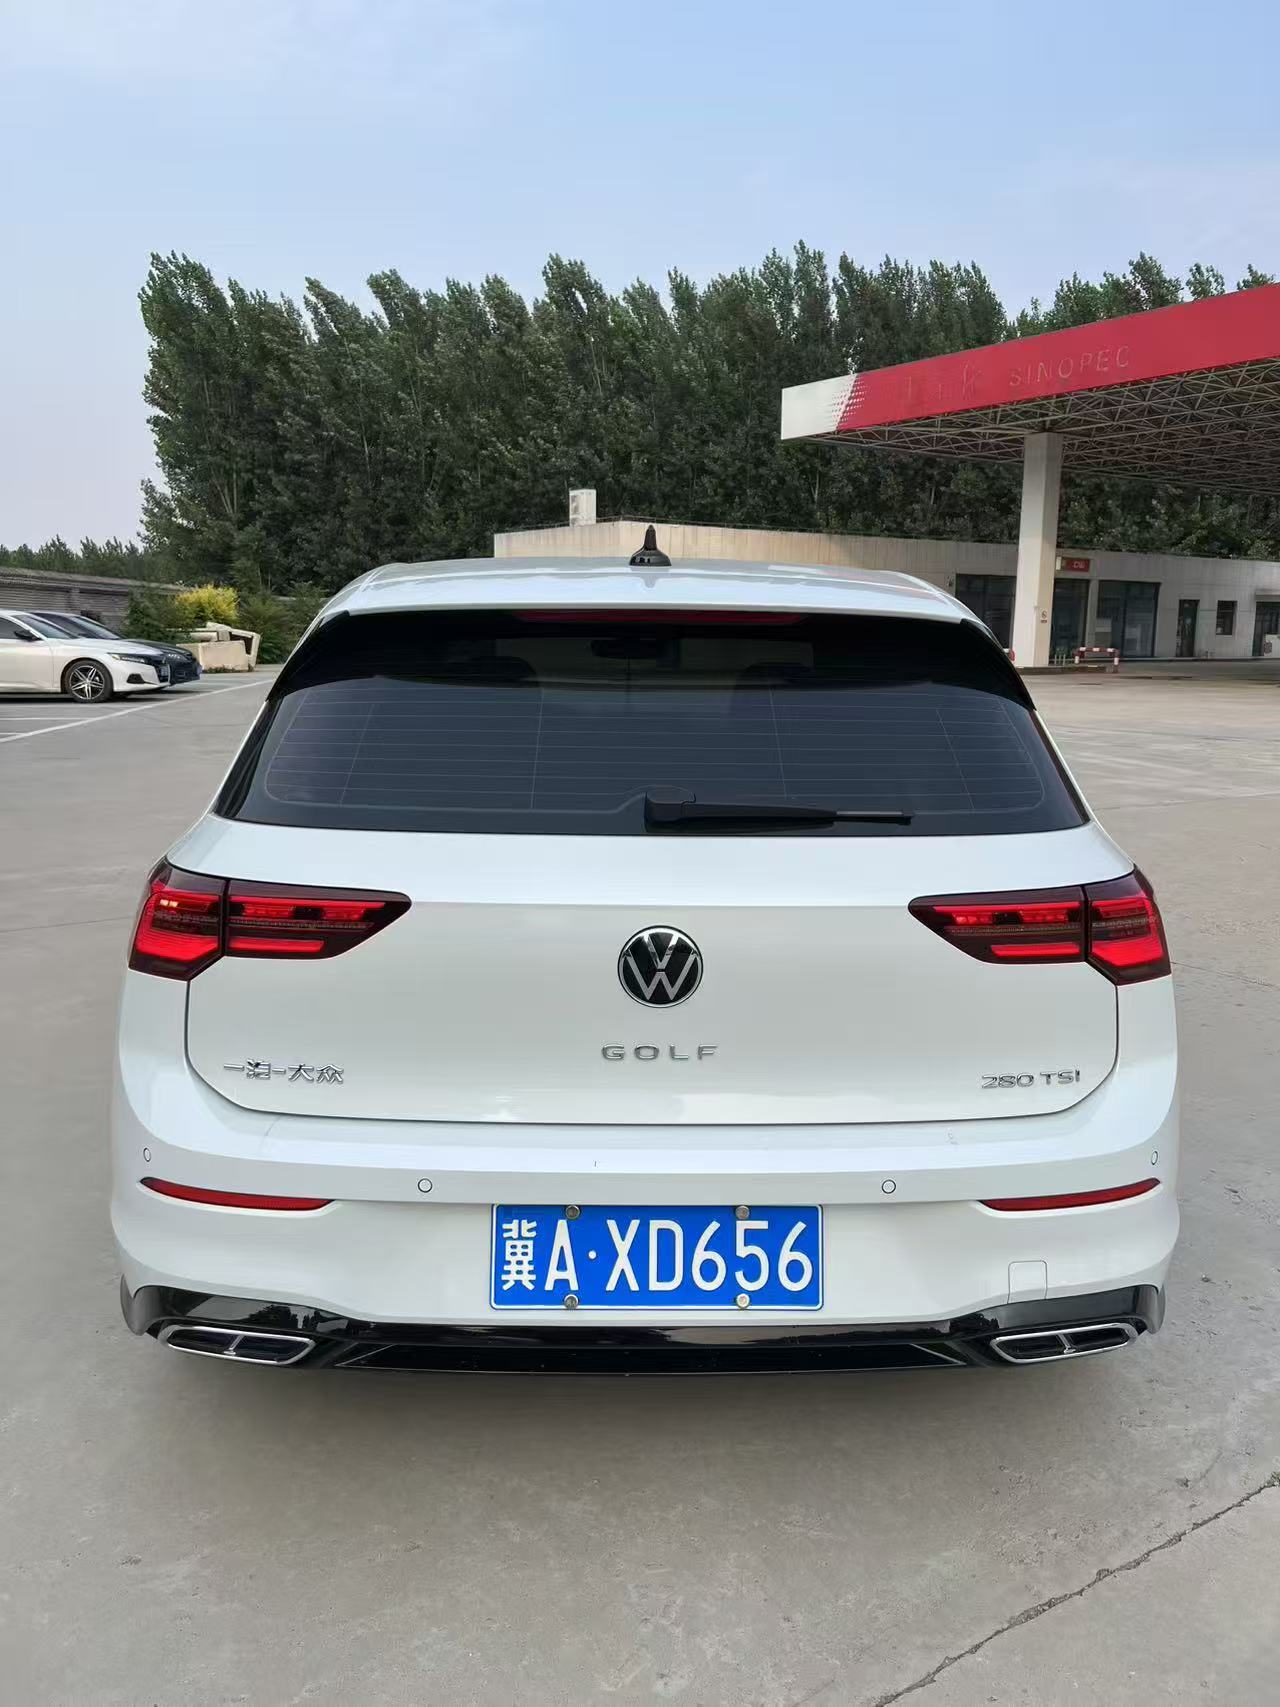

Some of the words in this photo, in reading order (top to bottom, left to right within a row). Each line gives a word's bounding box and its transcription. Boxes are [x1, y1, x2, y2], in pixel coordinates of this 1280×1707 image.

[1010, 346, 1130, 388] SINOPEC
[602, 1044, 719, 1061] GOLF
[982, 1073, 1035, 1089] 280
[1040, 1069, 1081, 1086] TSI
